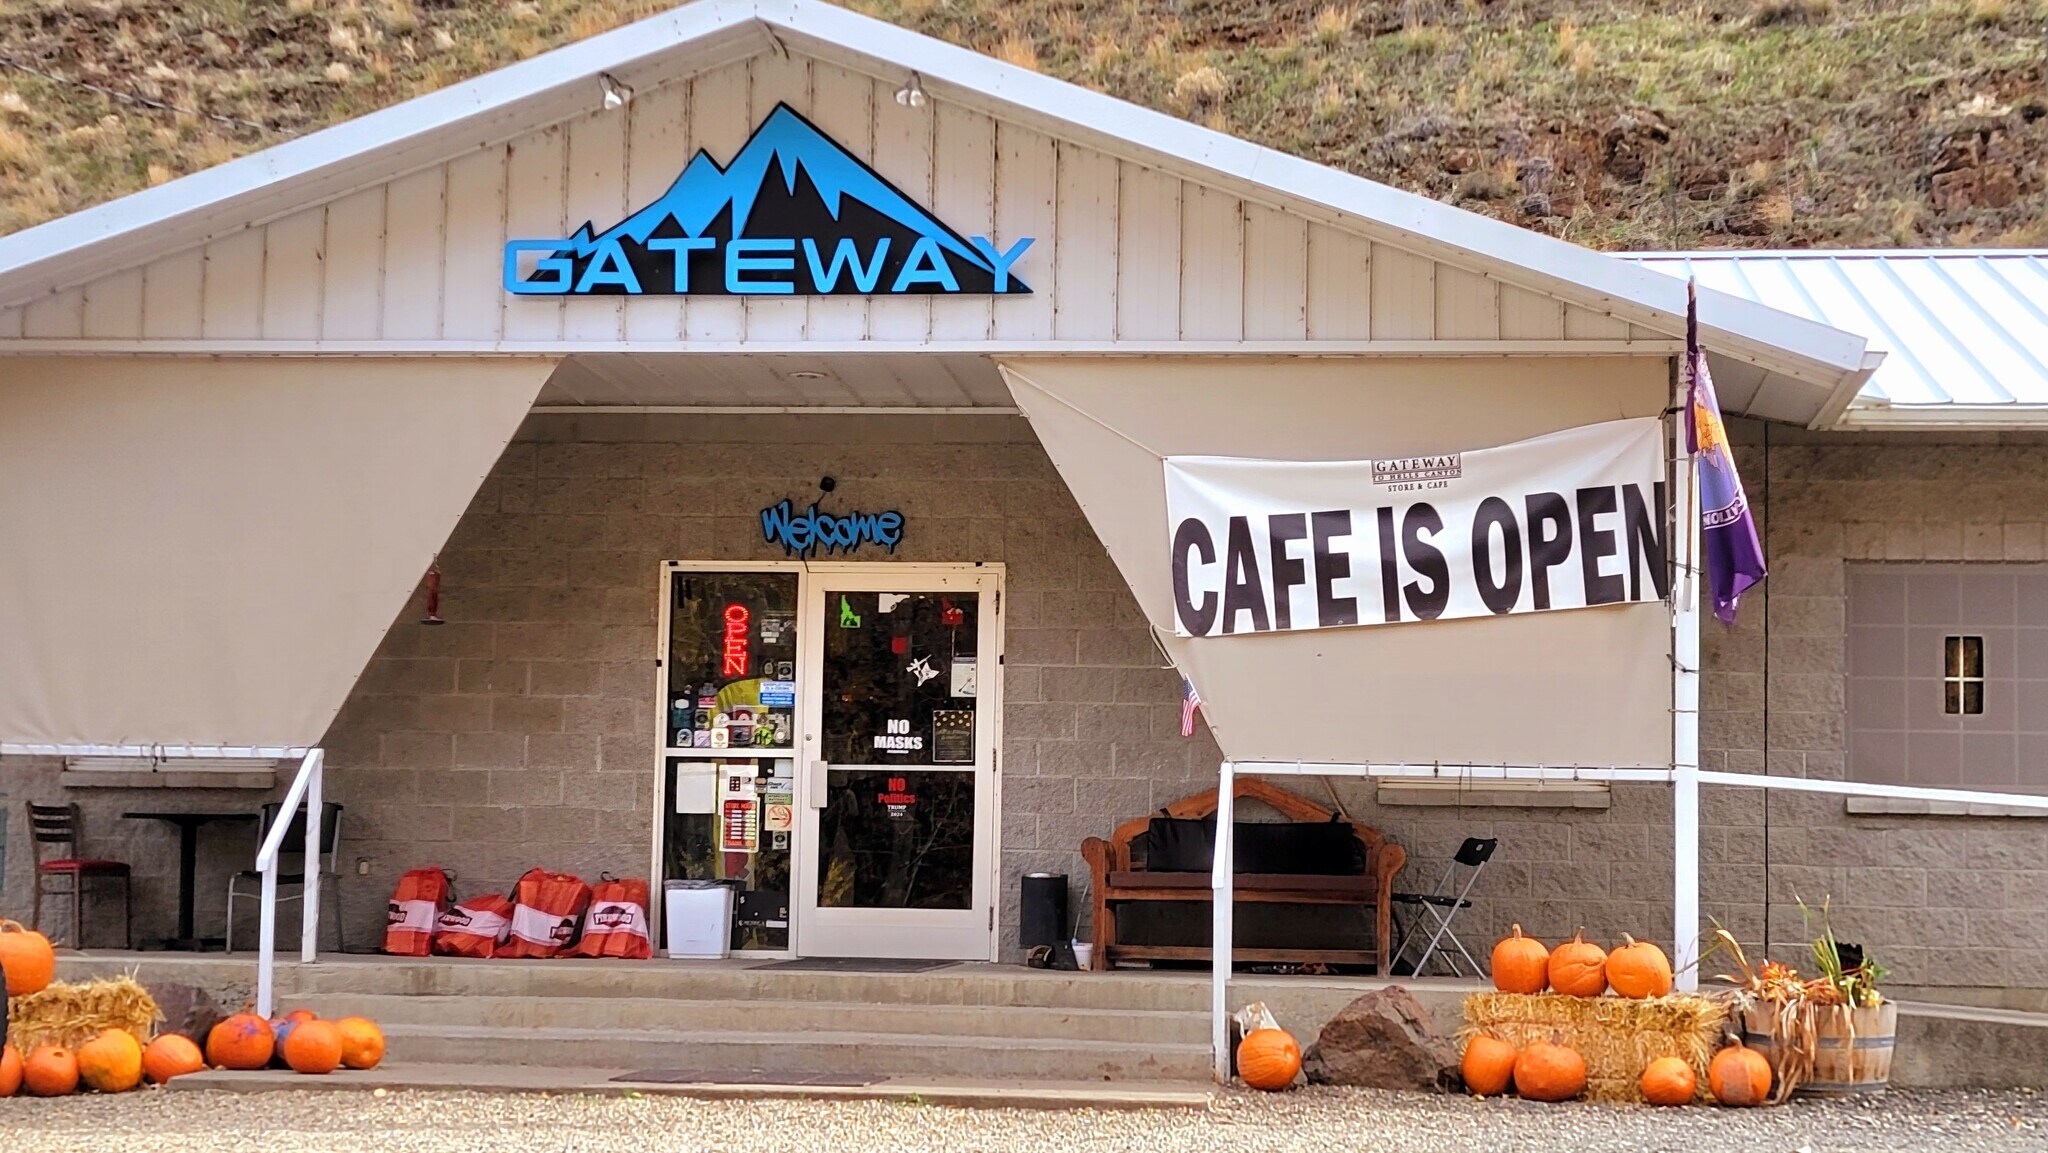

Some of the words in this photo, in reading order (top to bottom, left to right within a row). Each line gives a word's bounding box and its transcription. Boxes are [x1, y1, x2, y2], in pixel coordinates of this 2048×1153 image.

[503, 236, 1036, 294] GATEWAY
[1376, 456, 1456, 472] GATEWAY
[1390, 472, 1419, 480] HELLS
[1425, 469, 1462, 478] CANYON
[1388, 483, 1414, 492] STORE
[1427, 481, 1448, 489] CAFE
[760, 498, 905, 557] Welcome
[1172, 510, 1358, 638] CAFE
[1377, 502, 1450, 622] IS
[1472, 481, 1669, 615] OPEN
[724, 604, 749, 675] OPEN
[887, 719, 910, 734] NO
[873, 736, 923, 749] MASKS
[888, 778, 906, 792] NO
[878, 793, 916, 803] Politics
